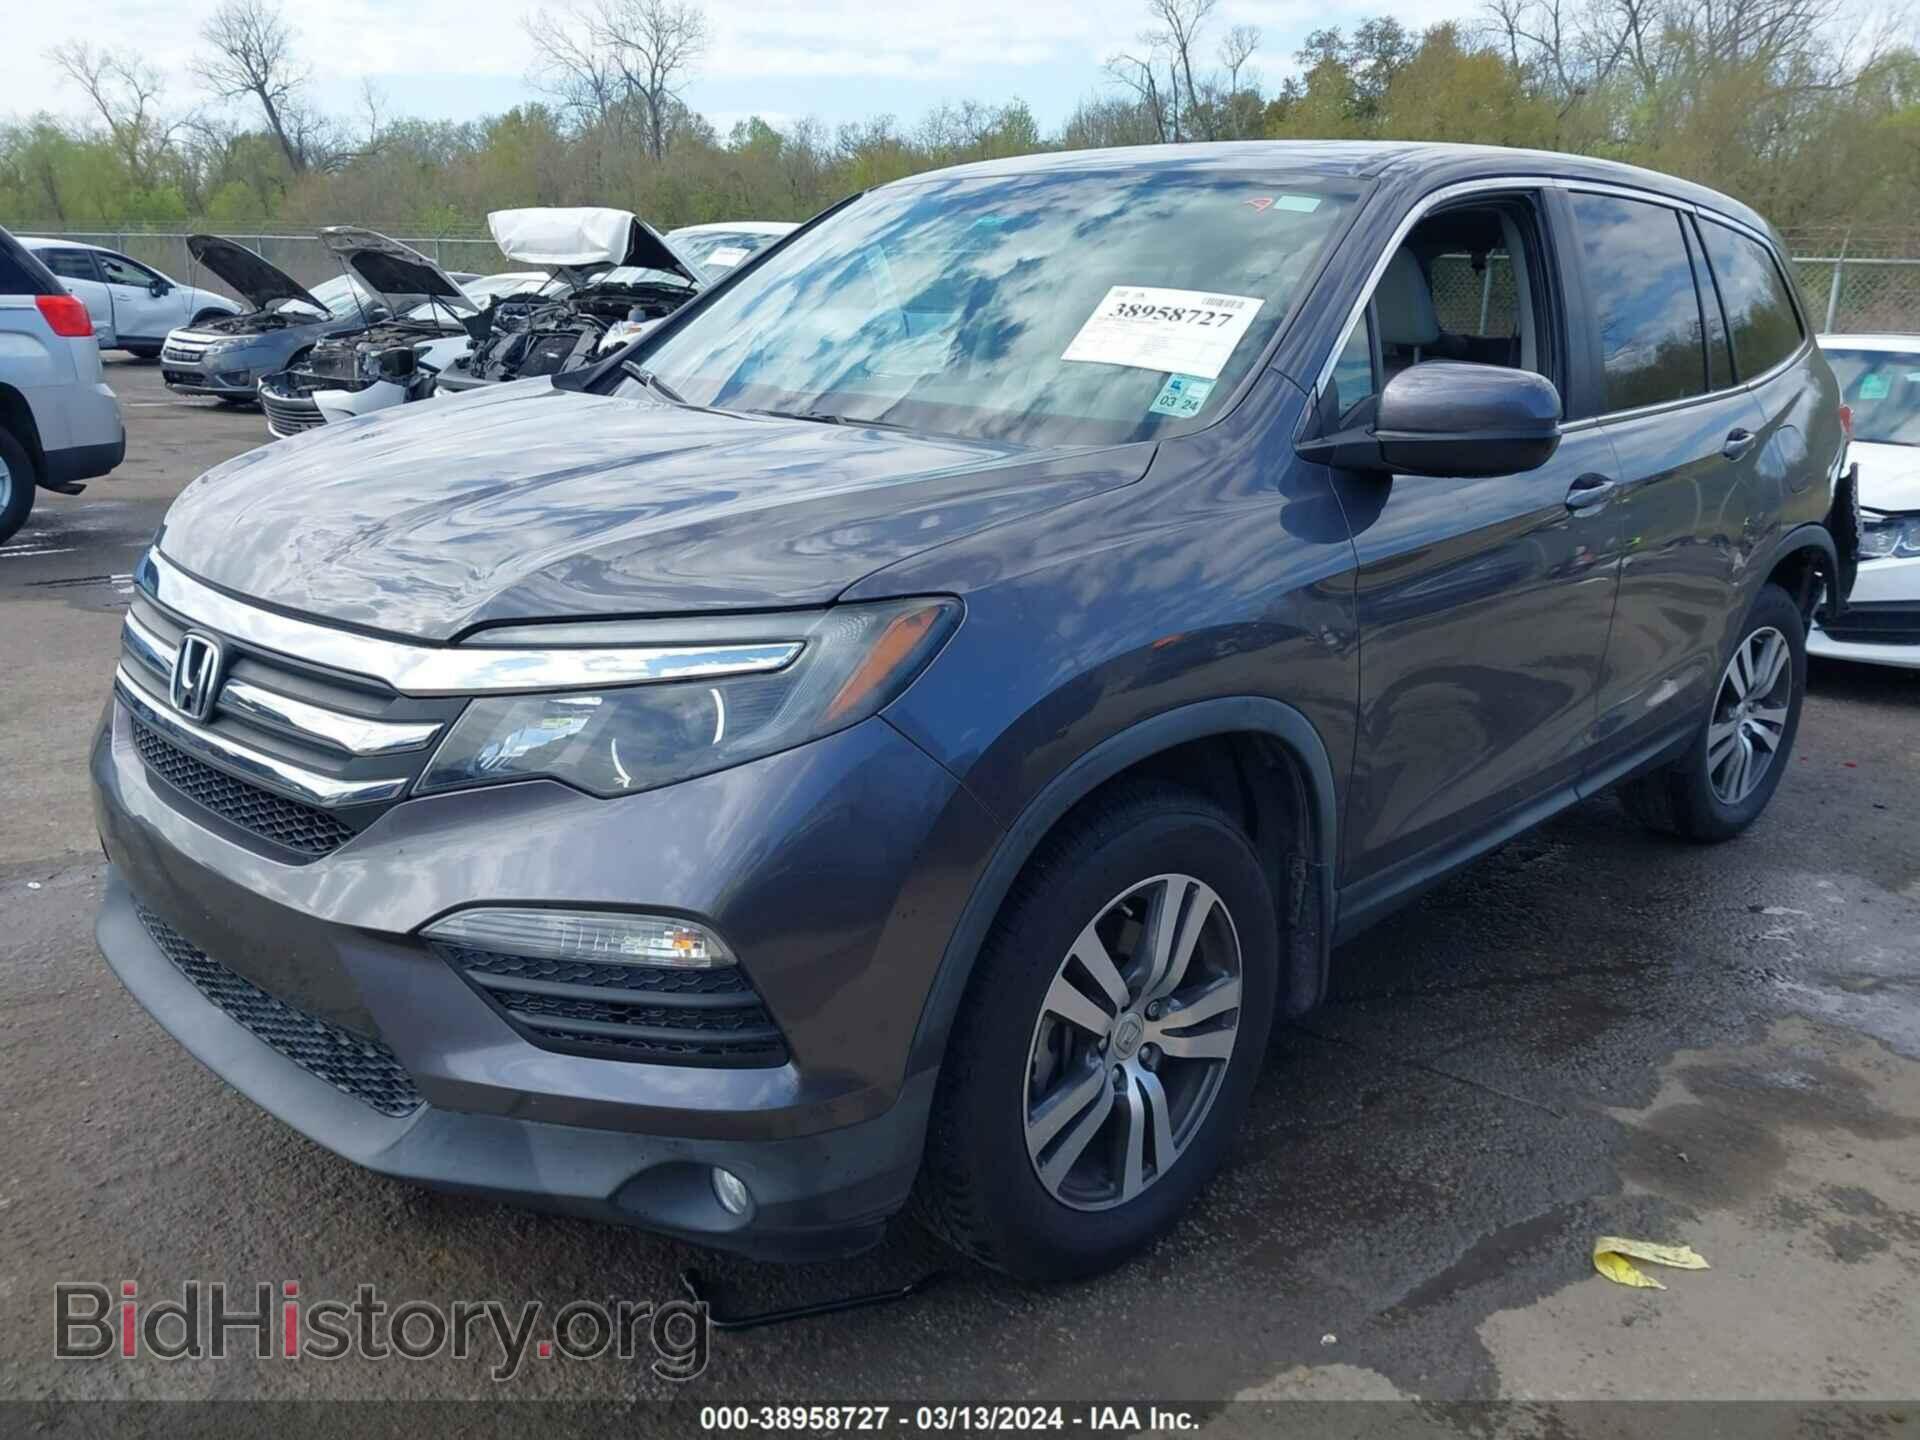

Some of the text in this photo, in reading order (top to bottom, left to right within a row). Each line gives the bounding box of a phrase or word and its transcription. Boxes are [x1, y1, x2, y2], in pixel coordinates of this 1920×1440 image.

[1108, 303, 1234, 327] 38958727
[1159, 395, 1199, 410] 03 24
